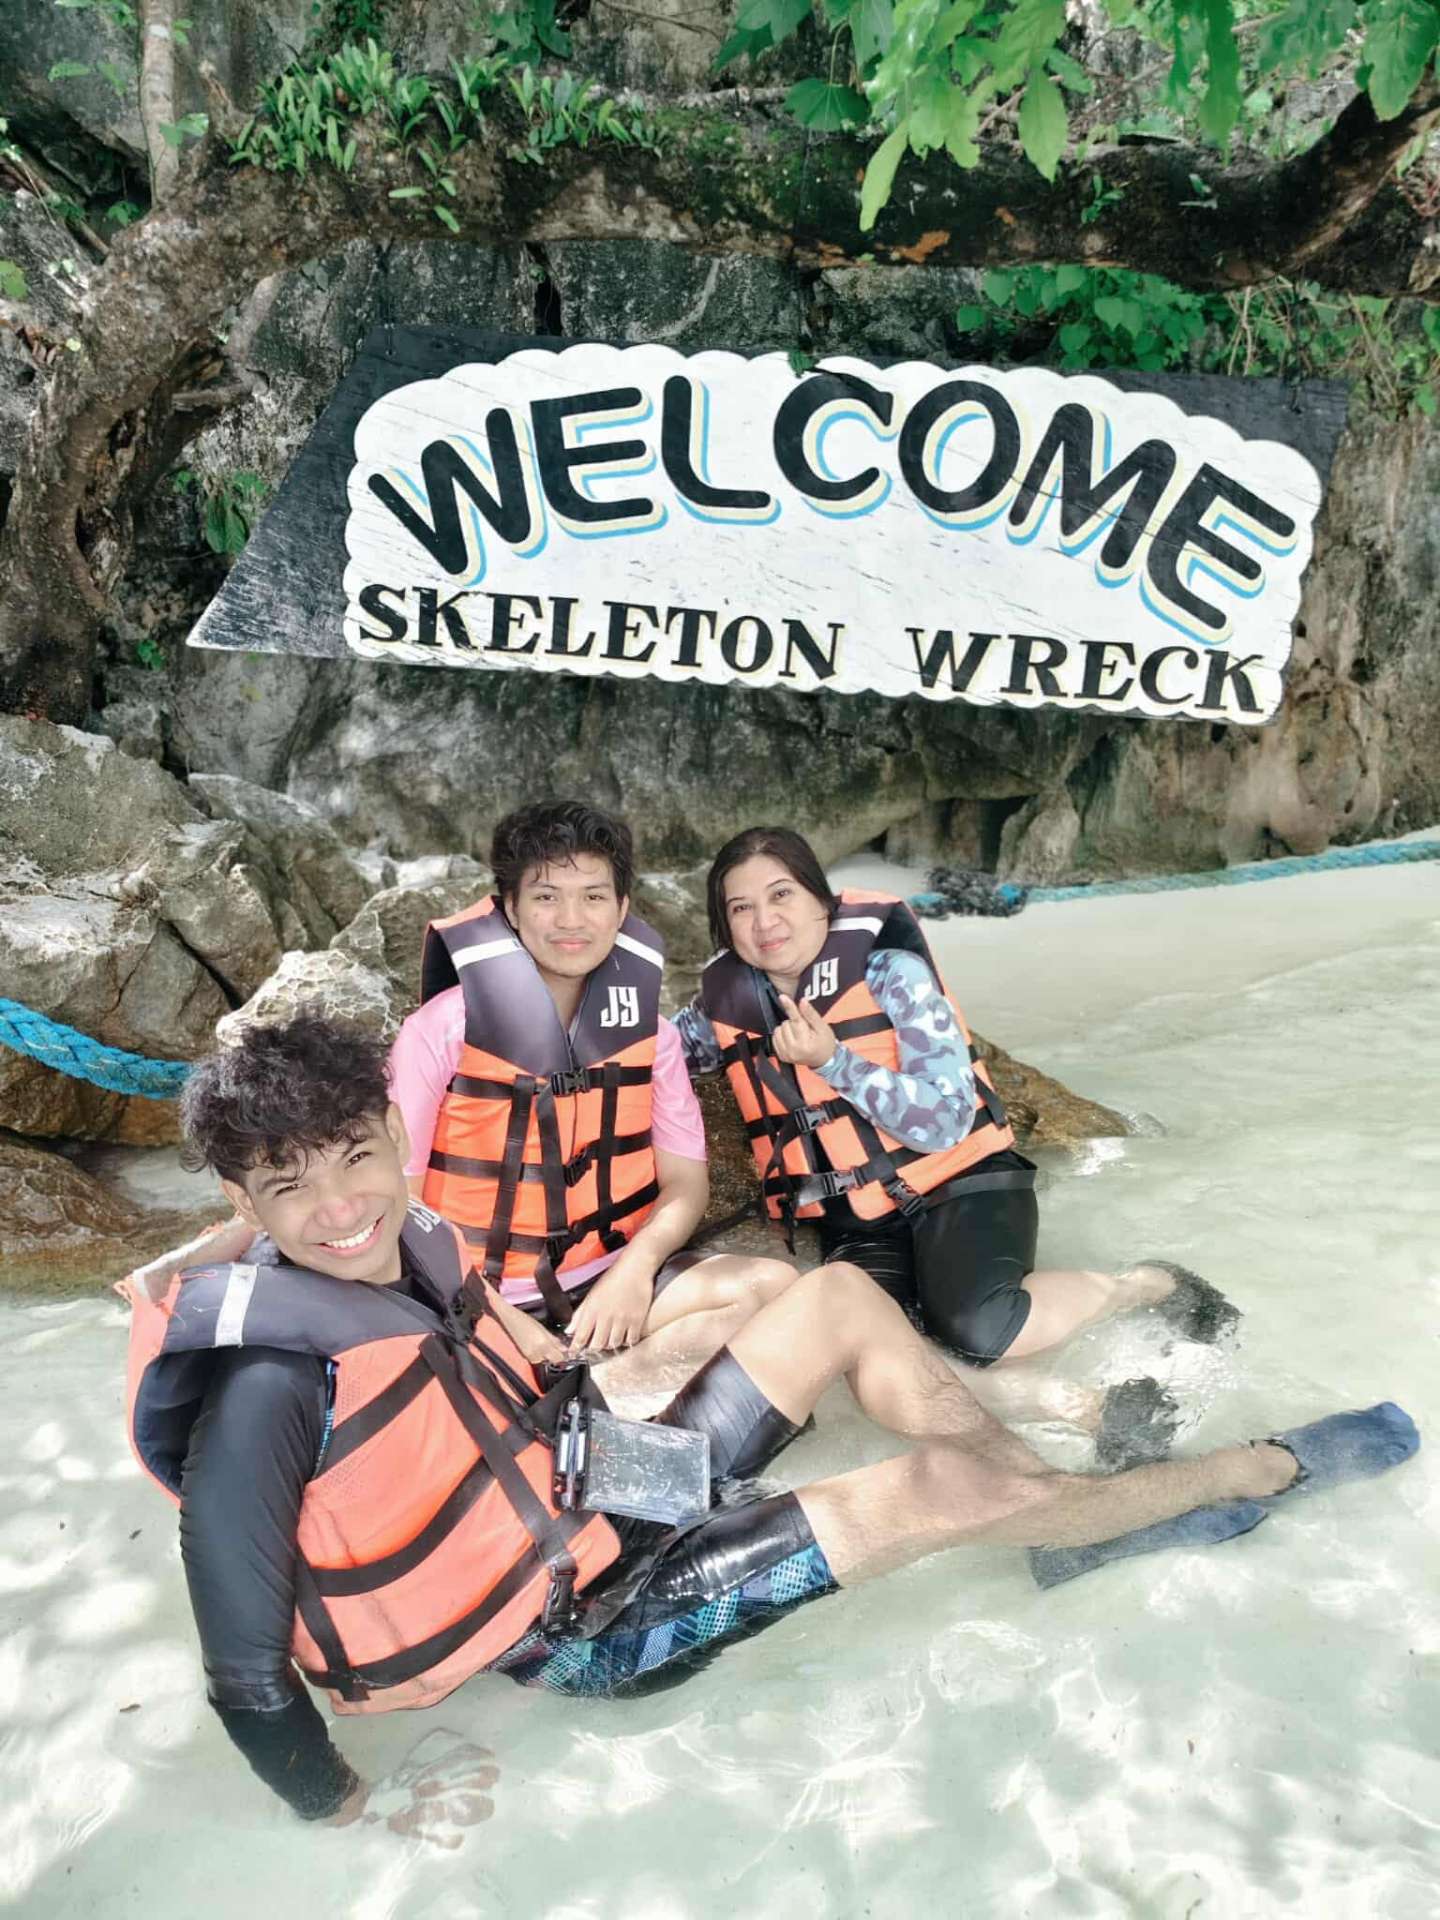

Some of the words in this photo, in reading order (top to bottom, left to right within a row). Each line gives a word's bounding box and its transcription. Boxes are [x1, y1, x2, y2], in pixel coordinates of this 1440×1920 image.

[367, 371, 1298, 640] WELCOME
[358, 583, 847, 680] SKELETON
[904, 626, 1265, 714] WRECK
[600, 986, 640, 1028] JY
[803, 957, 839, 1000] JY
